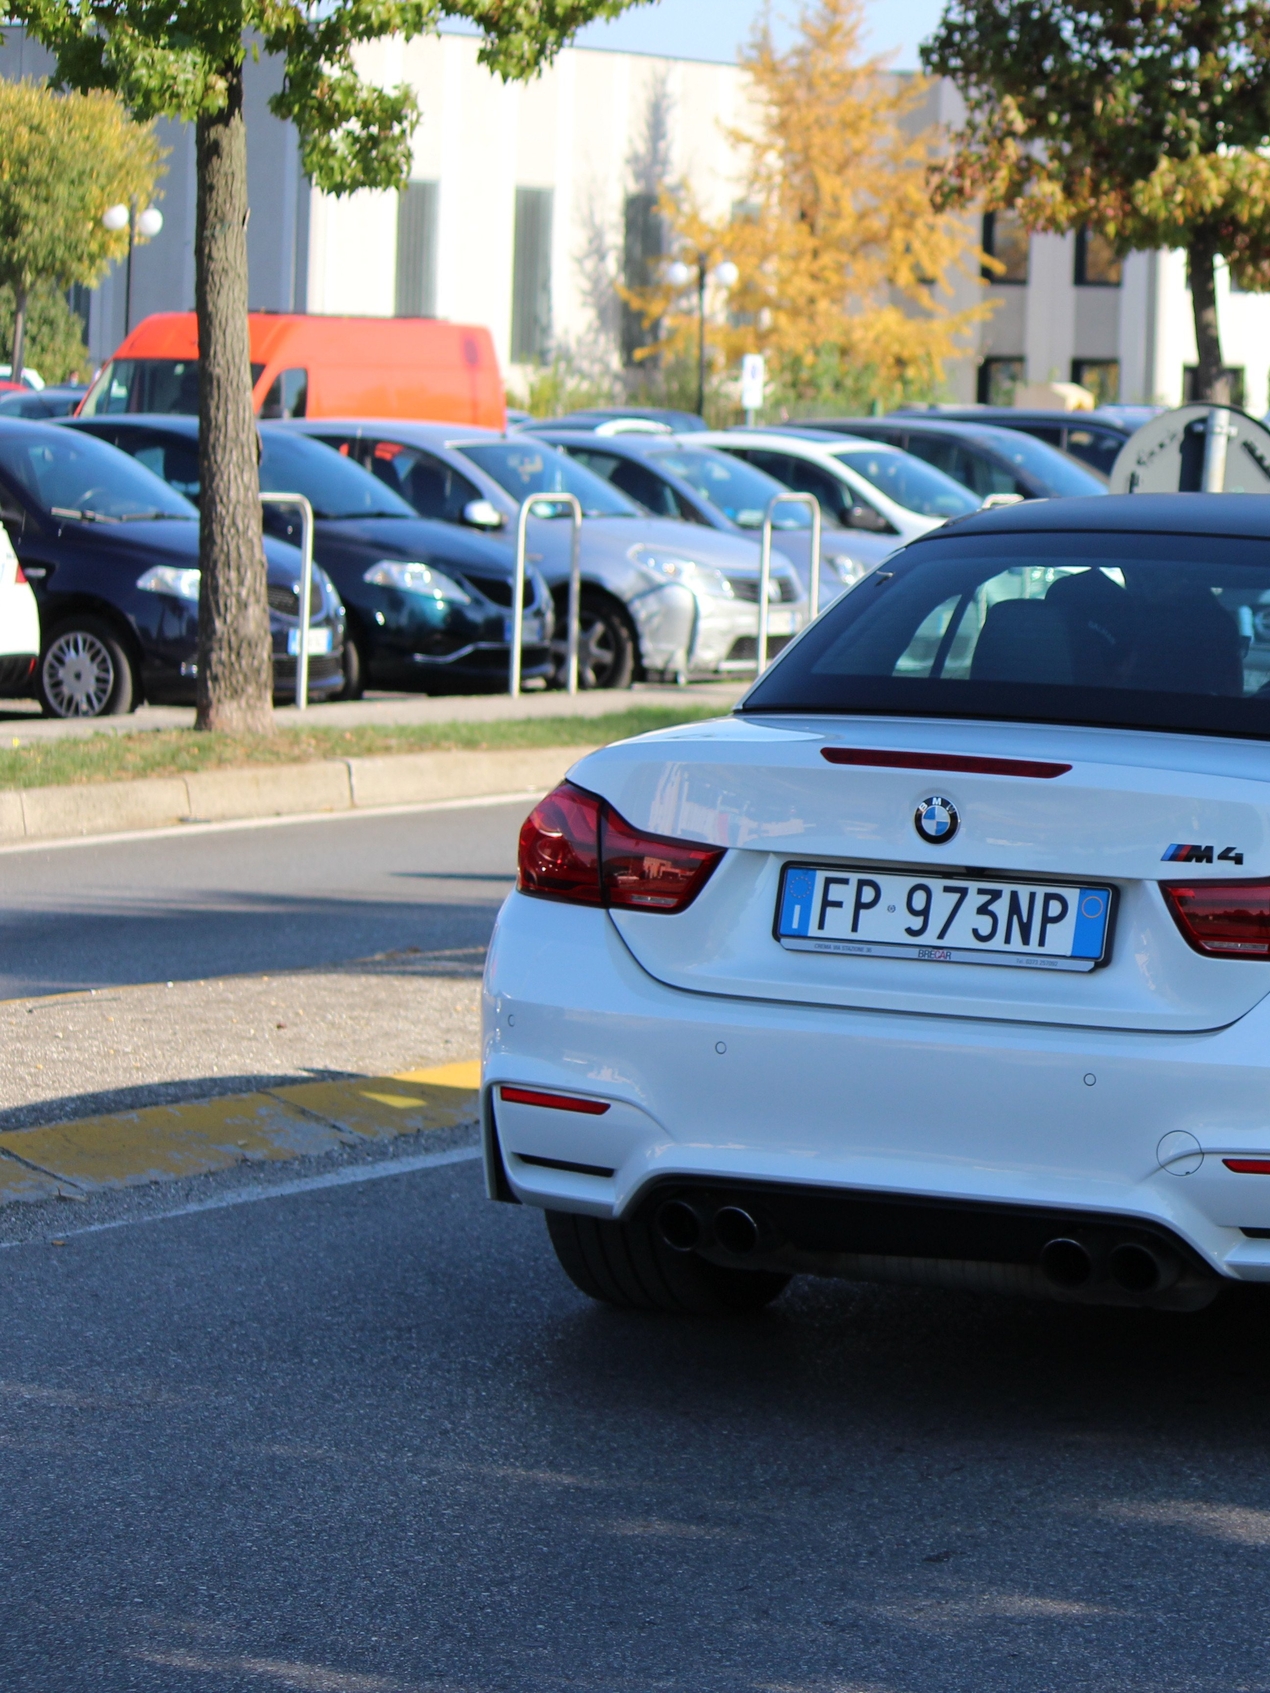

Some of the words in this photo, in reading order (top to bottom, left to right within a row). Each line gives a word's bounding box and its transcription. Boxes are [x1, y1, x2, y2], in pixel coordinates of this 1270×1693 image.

[919, 797, 956, 814] BMW
[817, 876, 882, 933] FP
[917, 949, 952, 960] BRECAR
